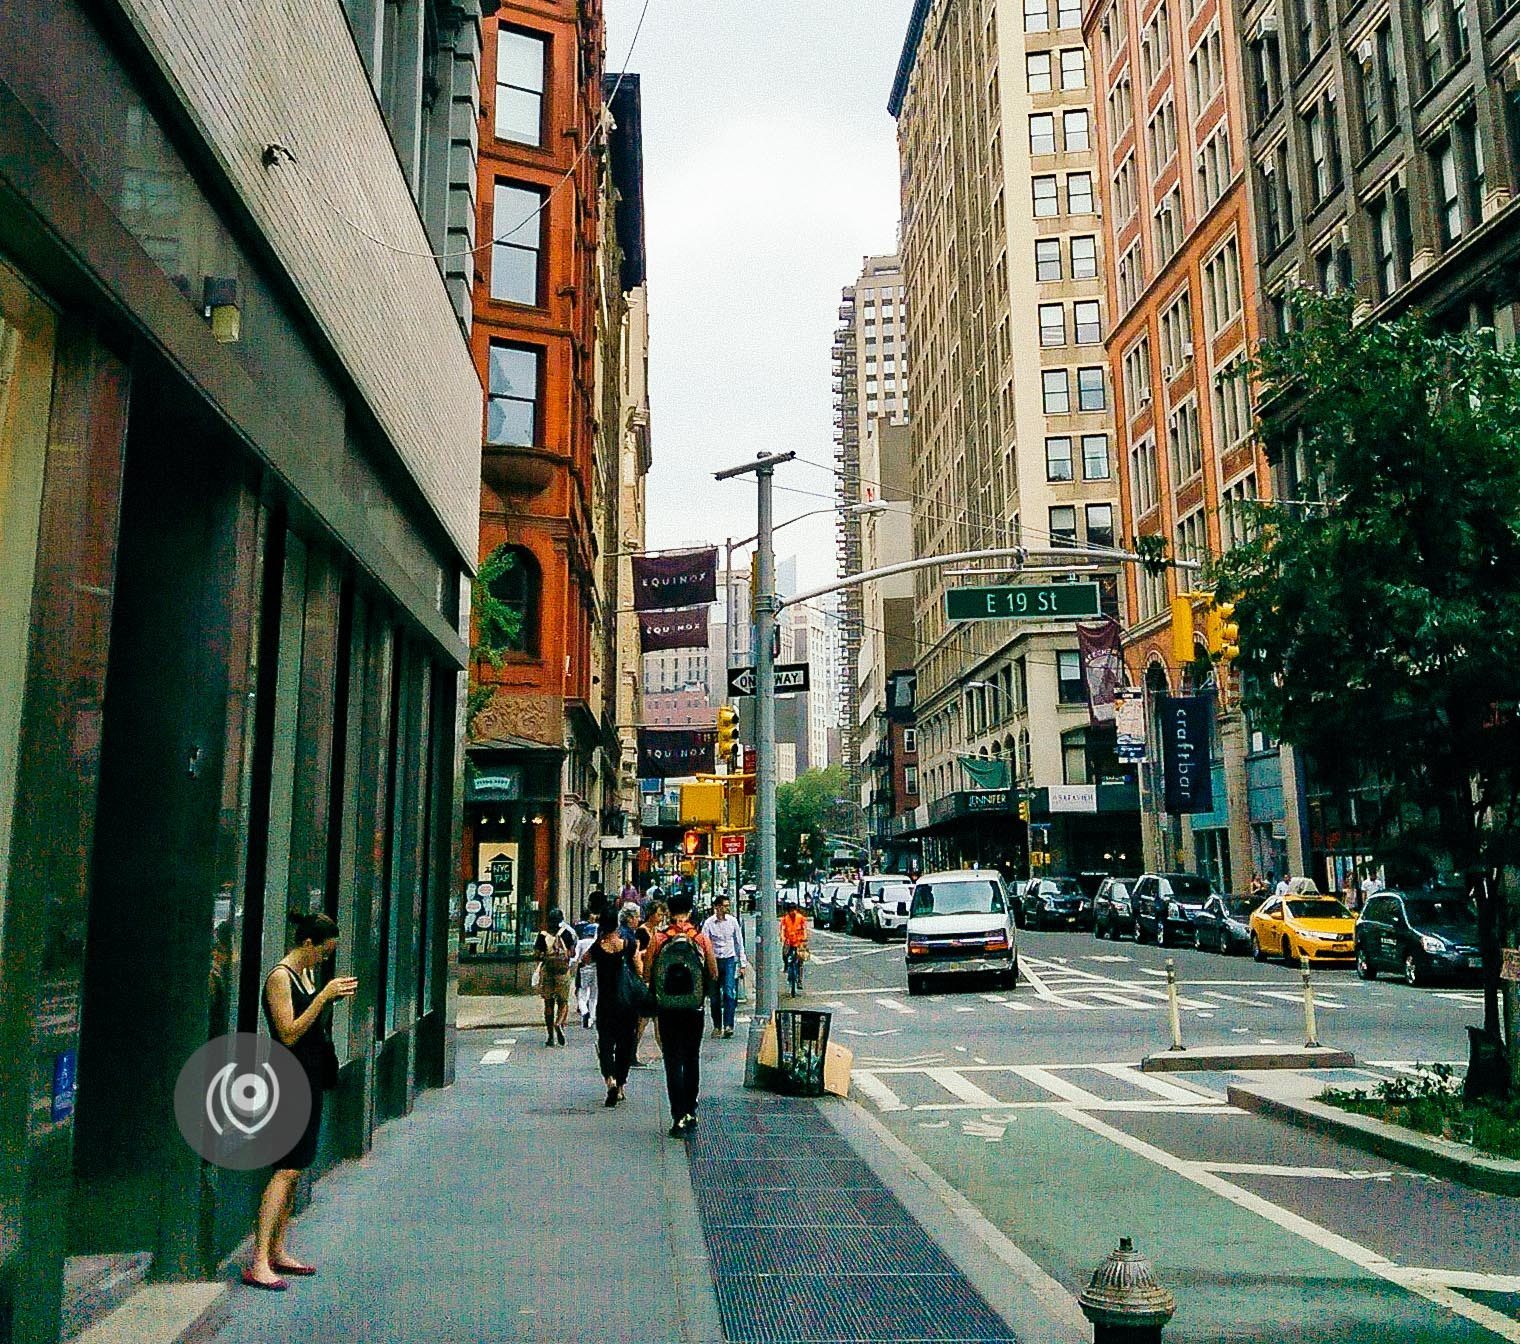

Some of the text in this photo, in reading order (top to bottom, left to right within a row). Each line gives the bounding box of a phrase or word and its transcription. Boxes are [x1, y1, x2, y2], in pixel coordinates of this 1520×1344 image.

[642, 572, 706, 587] EQUINOX
[986, 591, 1058, 613] E 19 St
[740, 672, 799, 687] ON WAY
[647, 747, 706, 759] QUNOX
[1177, 709, 1196, 798] craftbar
[969, 794, 1007, 806] JENNIFER
[493, 864, 511, 873] NYC
